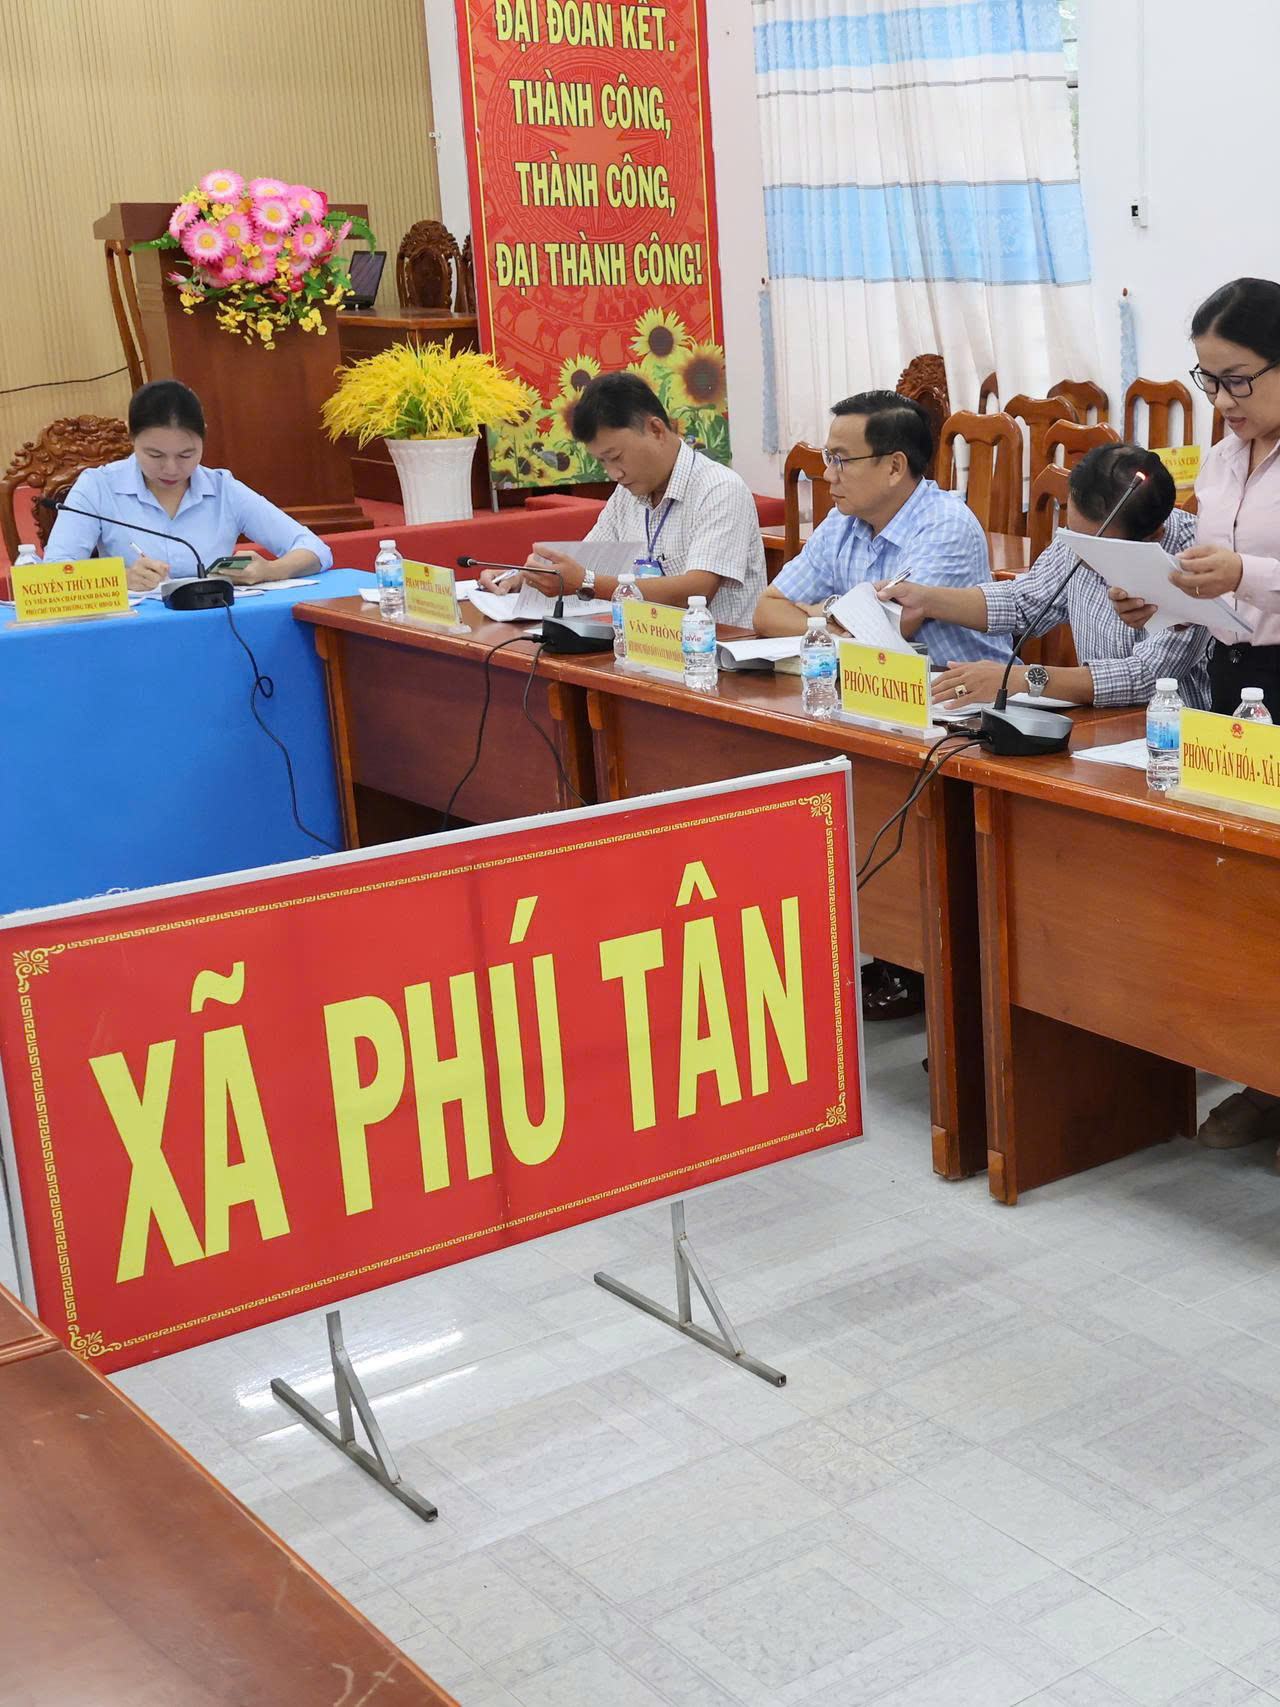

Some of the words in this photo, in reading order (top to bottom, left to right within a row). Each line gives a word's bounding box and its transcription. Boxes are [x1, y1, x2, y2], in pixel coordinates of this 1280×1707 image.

[495, 0, 540, 52] ĐẠI
[547, 0, 614, 48] ĐOAN
[508, 68, 594, 128] THÀNH
[601, 72, 672, 140] CÔNG,
[514, 150, 600, 207] THÀNH
[605, 153, 676, 218] CÔNG,
[495, 242, 540, 296] ĐẠI
[543, 230, 627, 287] THÀNH
[633, 231, 703, 286] CÔNG!
[94, 576, 119, 589] LINH
[629, 618, 648, 634] VĂN
[843, 666, 880, 697] PHÒNG
[881, 678, 909, 703] KINH
[910, 678, 926, 706] TẾ
[1183, 737, 1214, 774] PHÒNG
[1214, 743, 1235, 777] VĂN
[1236, 748, 1256, 782] HÓA
[88, 960, 293, 1284] XÃ
[322, 894, 567, 1217] PHÚ
[598, 860, 809, 1133] TÂN
